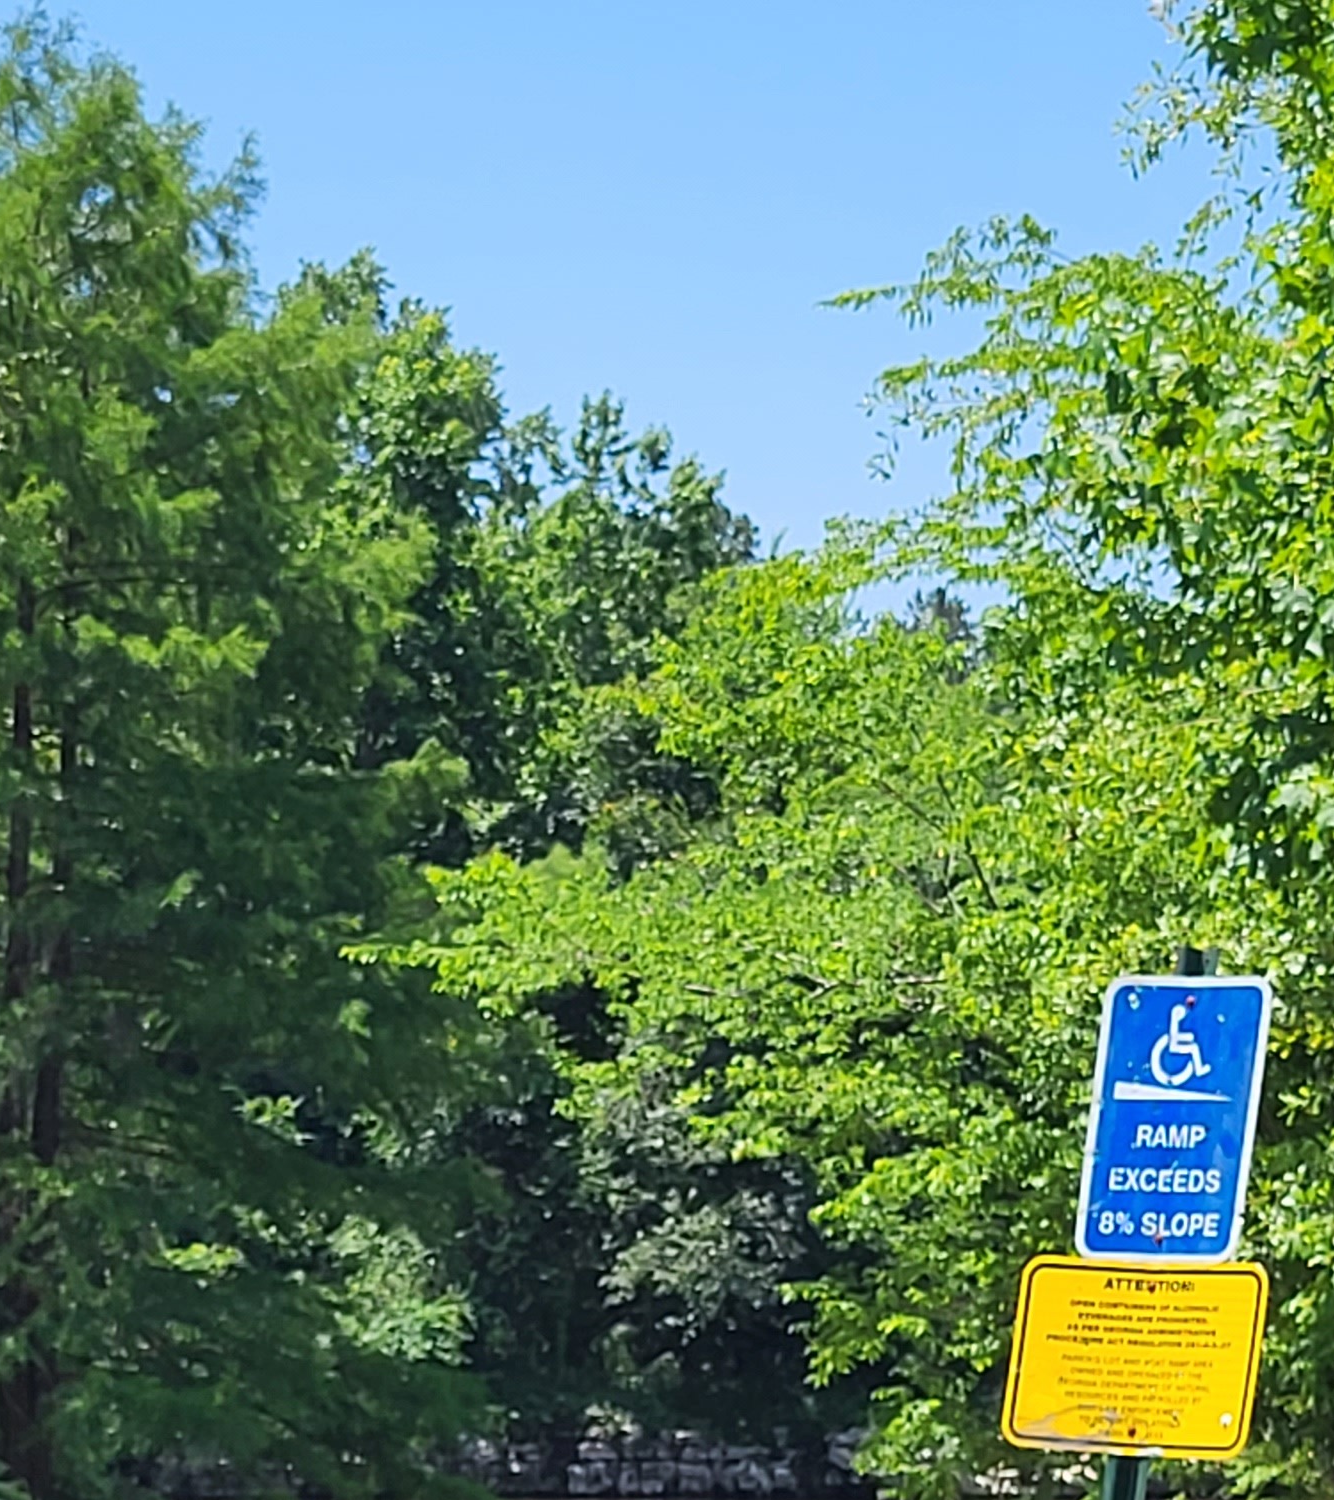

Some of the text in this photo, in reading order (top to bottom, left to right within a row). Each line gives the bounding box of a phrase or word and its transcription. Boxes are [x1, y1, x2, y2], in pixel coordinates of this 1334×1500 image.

[1135, 1124, 1207, 1149] RAMP
[1108, 1166, 1222, 1194] EXCEEDS
[1098, 1210, 1221, 1238] 8% SLOPE
